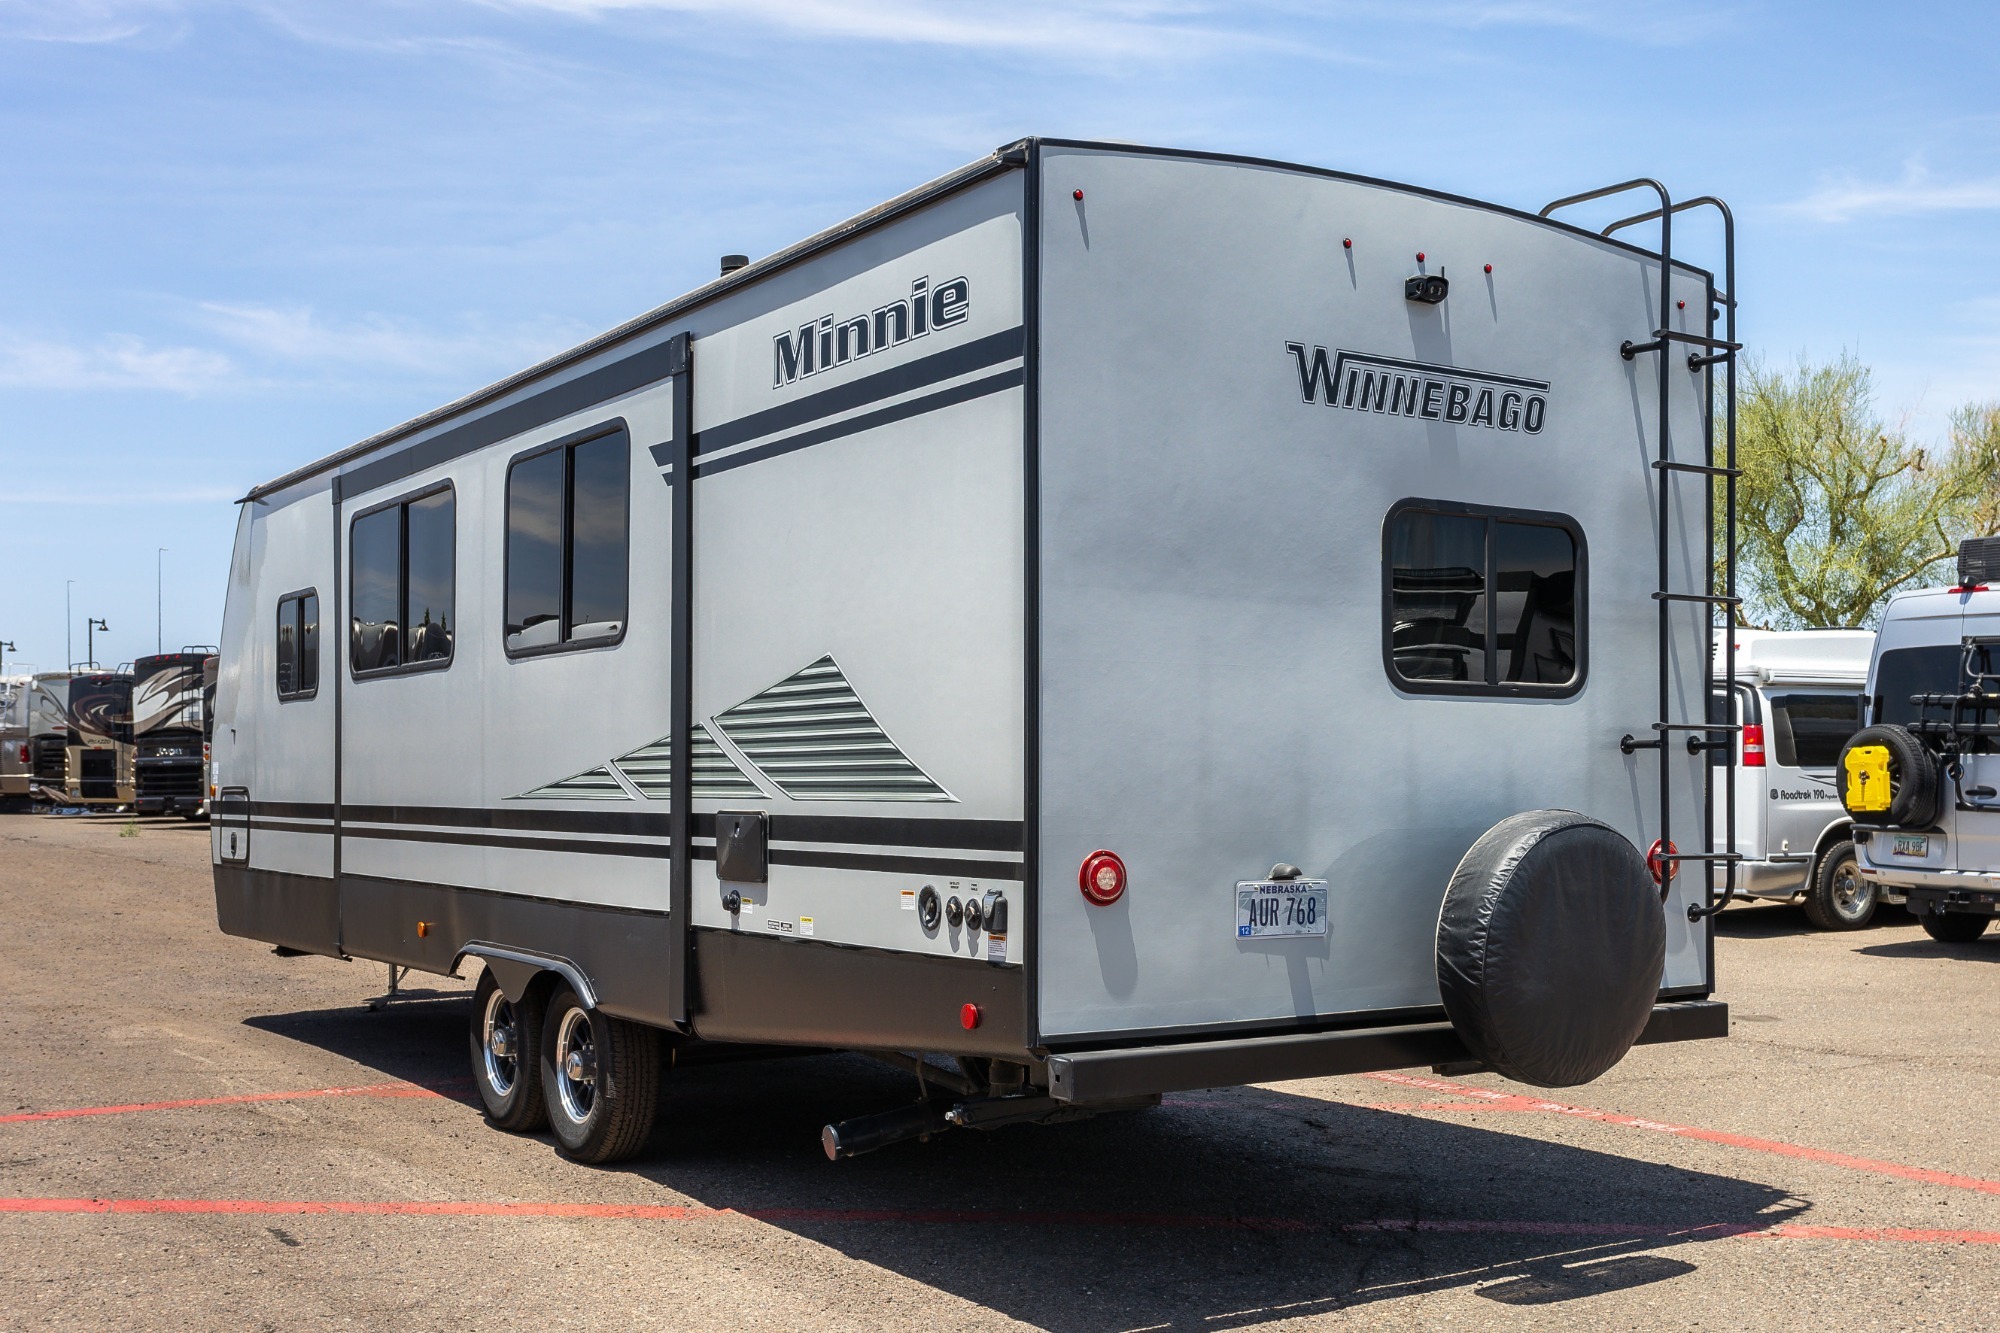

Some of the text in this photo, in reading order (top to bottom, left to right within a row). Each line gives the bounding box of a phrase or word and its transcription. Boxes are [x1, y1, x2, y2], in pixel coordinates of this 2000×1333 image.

[773, 275, 969, 389] Minnie
[1285, 341, 1551, 435] WINNEBAGO
[1781, 789, 1811, 800] Roadtrek
[1813, 789, 1825, 800] 190
[1259, 885, 1307, 894] NEBRASKA
[1249, 897, 1317, 927] AUR 768
[1241, 927, 1250, 935] 12
